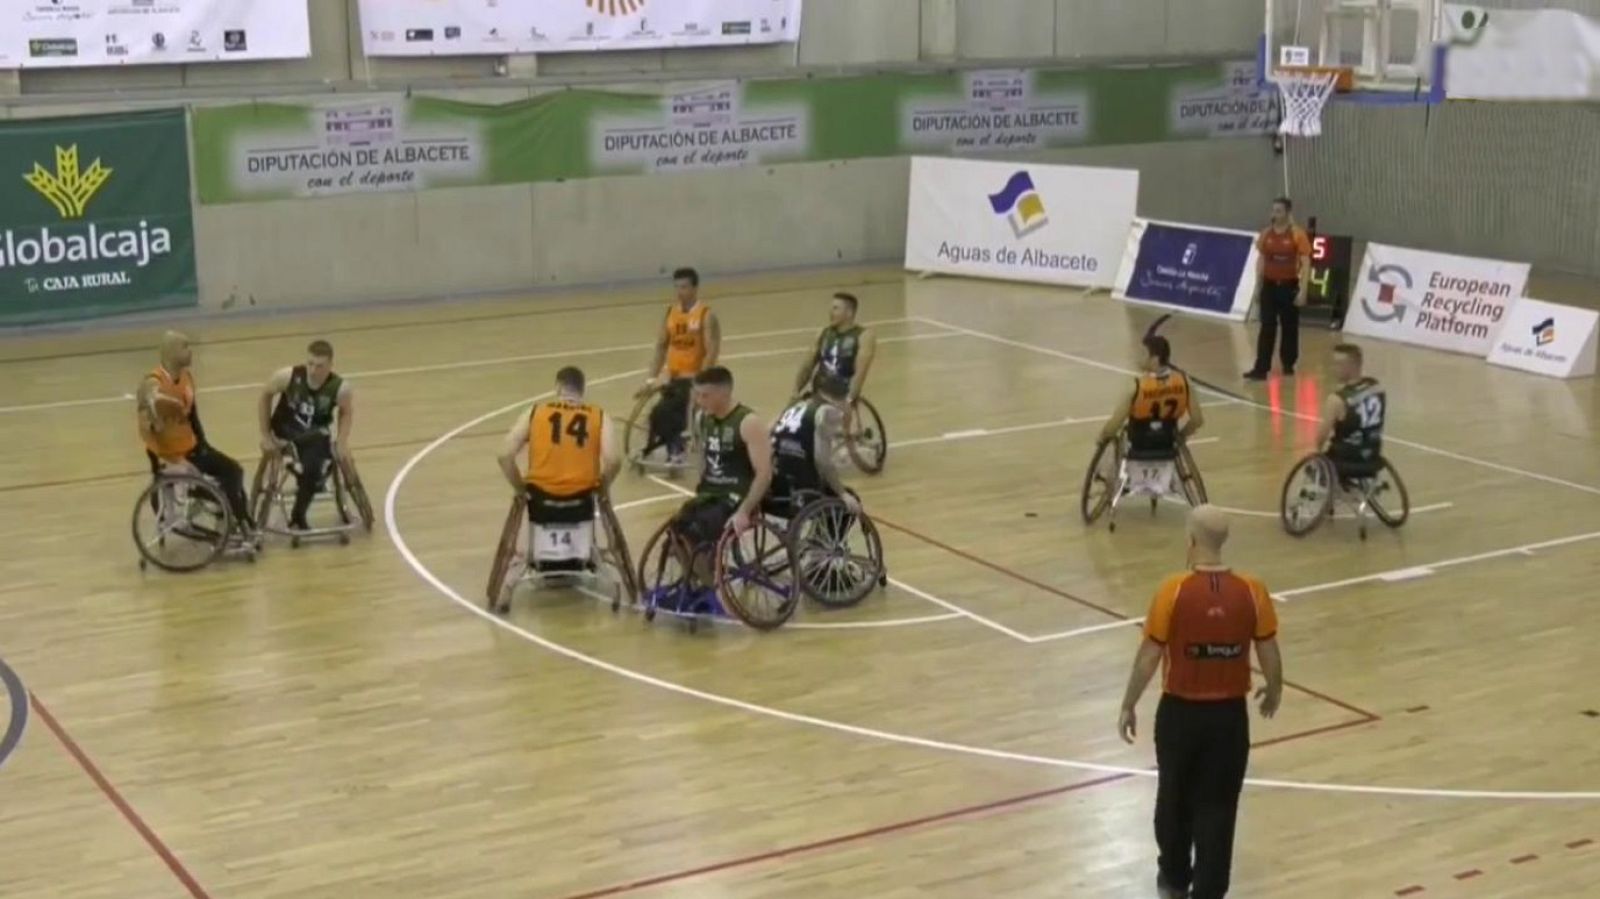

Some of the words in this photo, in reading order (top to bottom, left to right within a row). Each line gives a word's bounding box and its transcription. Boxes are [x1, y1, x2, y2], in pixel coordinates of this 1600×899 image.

[912, 113, 990, 131] DIPUTACIÓN
[993, 115, 1010, 128] DE
[1014, 112, 1078, 128] ALBACETE
[605, 132, 695, 151] DIPUTACIÓN
[698, 131, 717, 145] DE
[722, 124, 796, 144] ALBACETE
[247, 150, 351, 173] DIPUTACIÓN
[356, 149, 378, 165] DE
[383, 145, 469, 164] ALBACETE
[656, 156, 677, 167] con
[683, 151, 695, 164] el
[701, 149, 749, 165] deporte
[307, 177, 332, 189] con
[339, 171, 354, 187] el
[359, 169, 415, 188] deporte
[0, 220, 171, 267] lobalcaja
[937, 241, 991, 264] Aguas
[996, 245, 1017, 264] de
[1021, 248, 1098, 272] Albacete
[1312, 237, 1326, 259] 5
[43, 276, 79, 291] CAJA
[82, 271, 131, 288] RURAL
[1429, 271, 1511, 297] European
[1420, 292, 1505, 322] Recycling
[1415, 311, 1488, 338] Platform
[775, 401, 807, 433] 94
[1356, 395, 1382, 428] 12
[548, 411, 589, 447] 14
[1142, 468, 1159, 480] 17
[550, 531, 571, 547] 14
